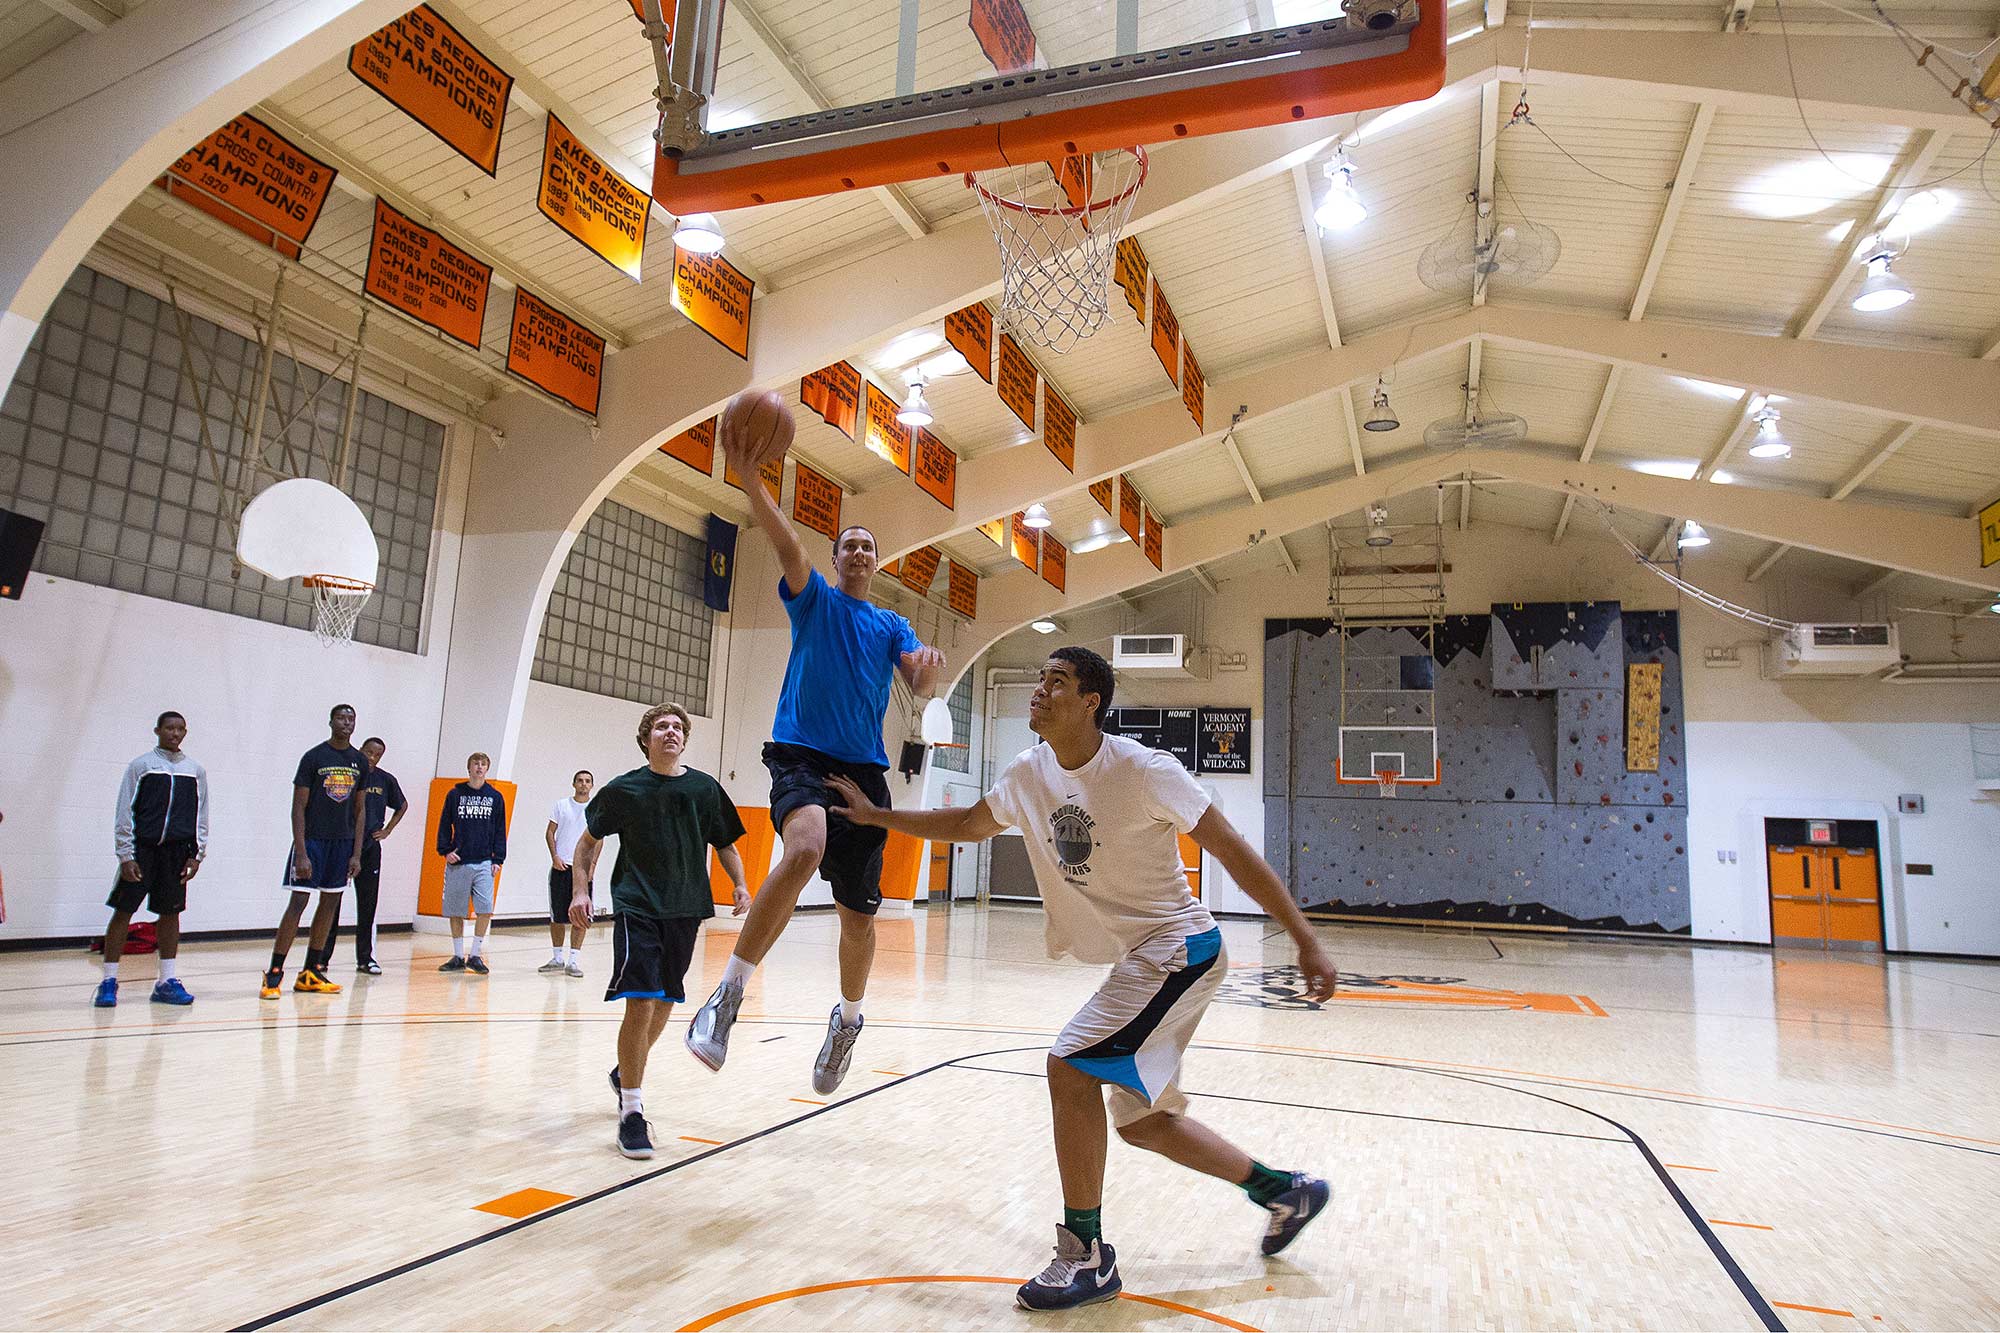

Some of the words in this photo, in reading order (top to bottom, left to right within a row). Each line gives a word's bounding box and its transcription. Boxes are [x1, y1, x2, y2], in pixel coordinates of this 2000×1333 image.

[431, 48, 497, 111] SOCCER
[441, 35, 502, 93] REGION
[185, 145, 309, 223] HAMPIONS
[215, 133, 259, 167] CROSS
[262, 161, 318, 202] COUNTRY
[255, 137, 305, 177] CLASS
[308, 171, 319, 184] B
[553, 128, 602, 176] LAKES
[602, 172, 645, 212] REGION
[553, 146, 586, 186] BOYS
[588, 182, 642, 225] SOCCER
[549, 164, 637, 242] CHAMPIONS
[380, 211, 429, 250] LAKES
[438, 247, 486, 285] REGION
[383, 231, 421, 262] CROSS
[430, 258, 479, 295] COUNTRY
[380, 247, 477, 313] CHAMPIONS
[678, 264, 745, 326] CHAMPIONS
[687, 255, 741, 306] FOOTBALL
[715, 263, 749, 297] REGION
[519, 294, 568, 332] EVERGREEN
[529, 315, 589, 360] FOOTBALL
[518, 321, 597, 378] CHAMPIONS
[1167, 710, 1192, 718] HOME
[1202, 722, 1246, 732] ACADEMY
[1203, 712, 1246, 723] VERMONT
[1202, 759, 1246, 769] WILDCATS
[1206, 751, 1223, 759] home
[457, 805, 493, 816] COWBOYS
[459, 795, 494, 806] DALLAS
